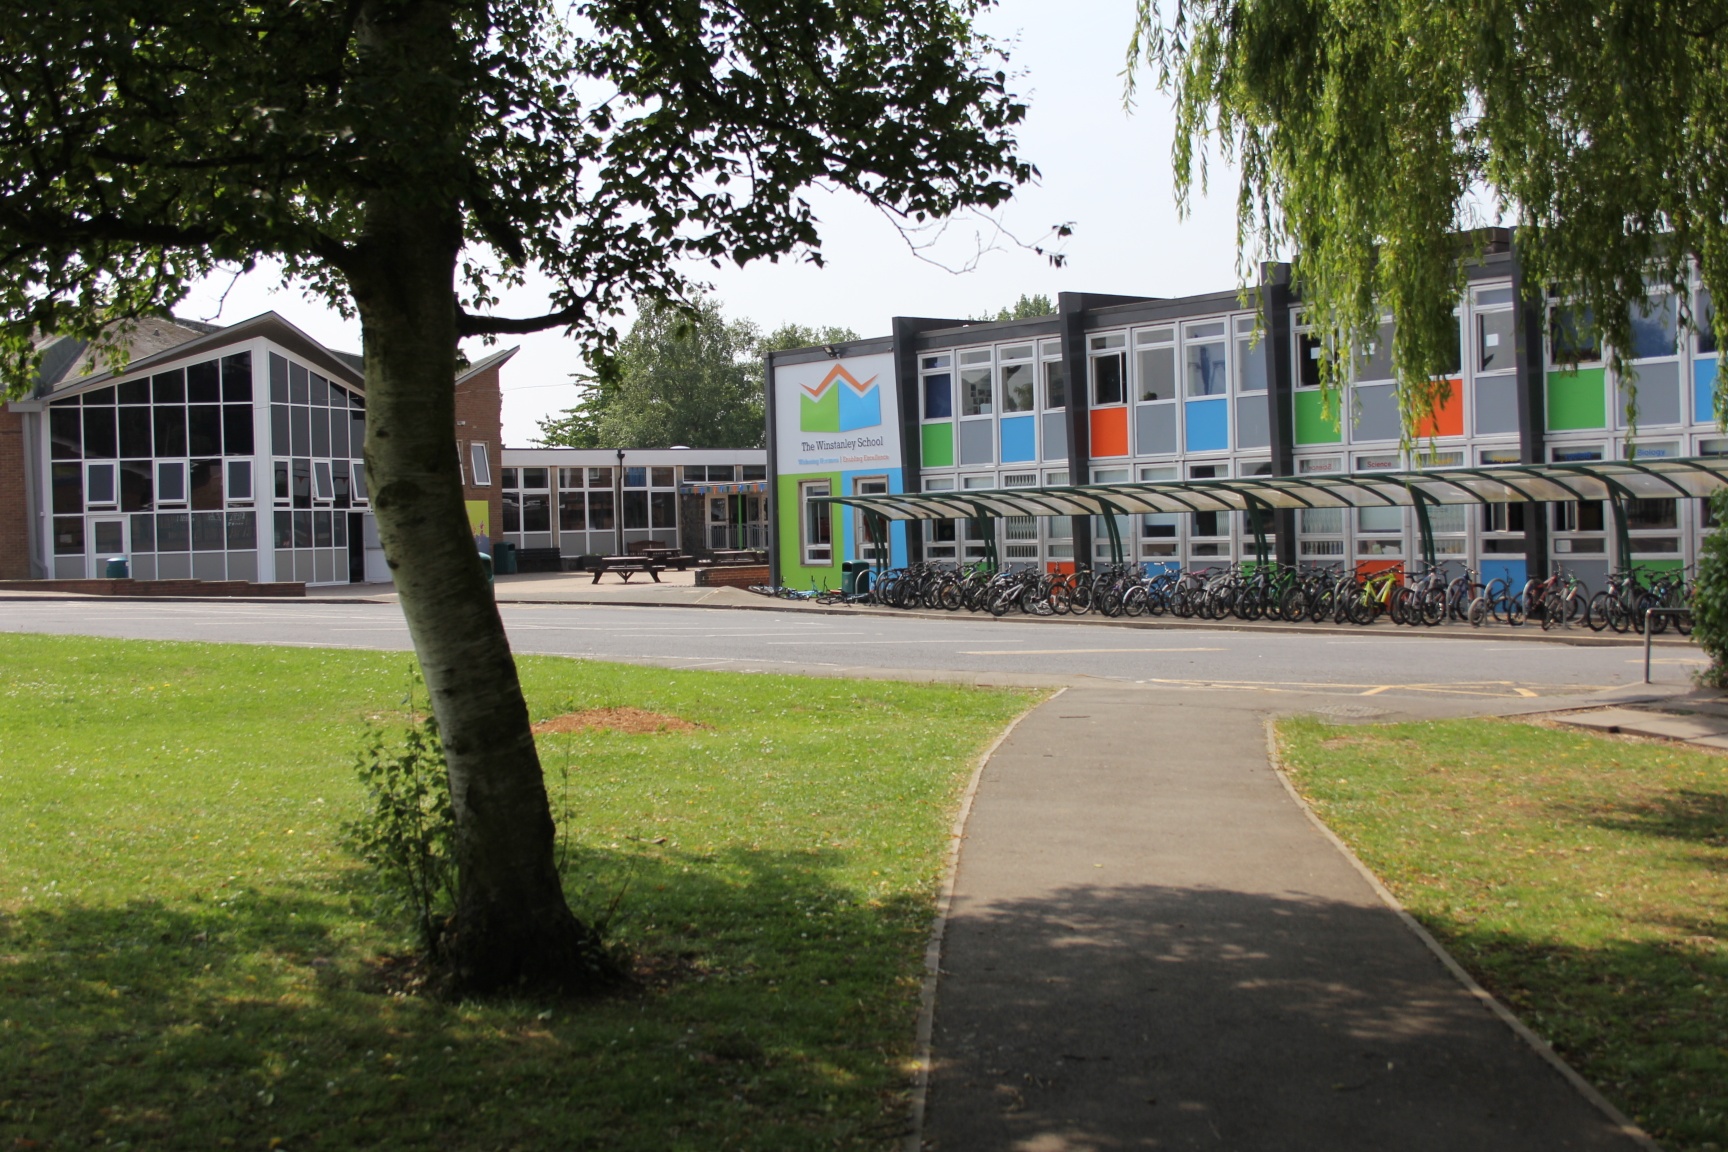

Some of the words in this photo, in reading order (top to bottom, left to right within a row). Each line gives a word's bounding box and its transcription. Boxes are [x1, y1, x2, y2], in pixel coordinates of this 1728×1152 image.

[801, 442, 815, 451] The
[816, 439, 856, 450] Winstanley
[858, 436, 883, 447] School
[1637, 449, 1665, 457] Biology
